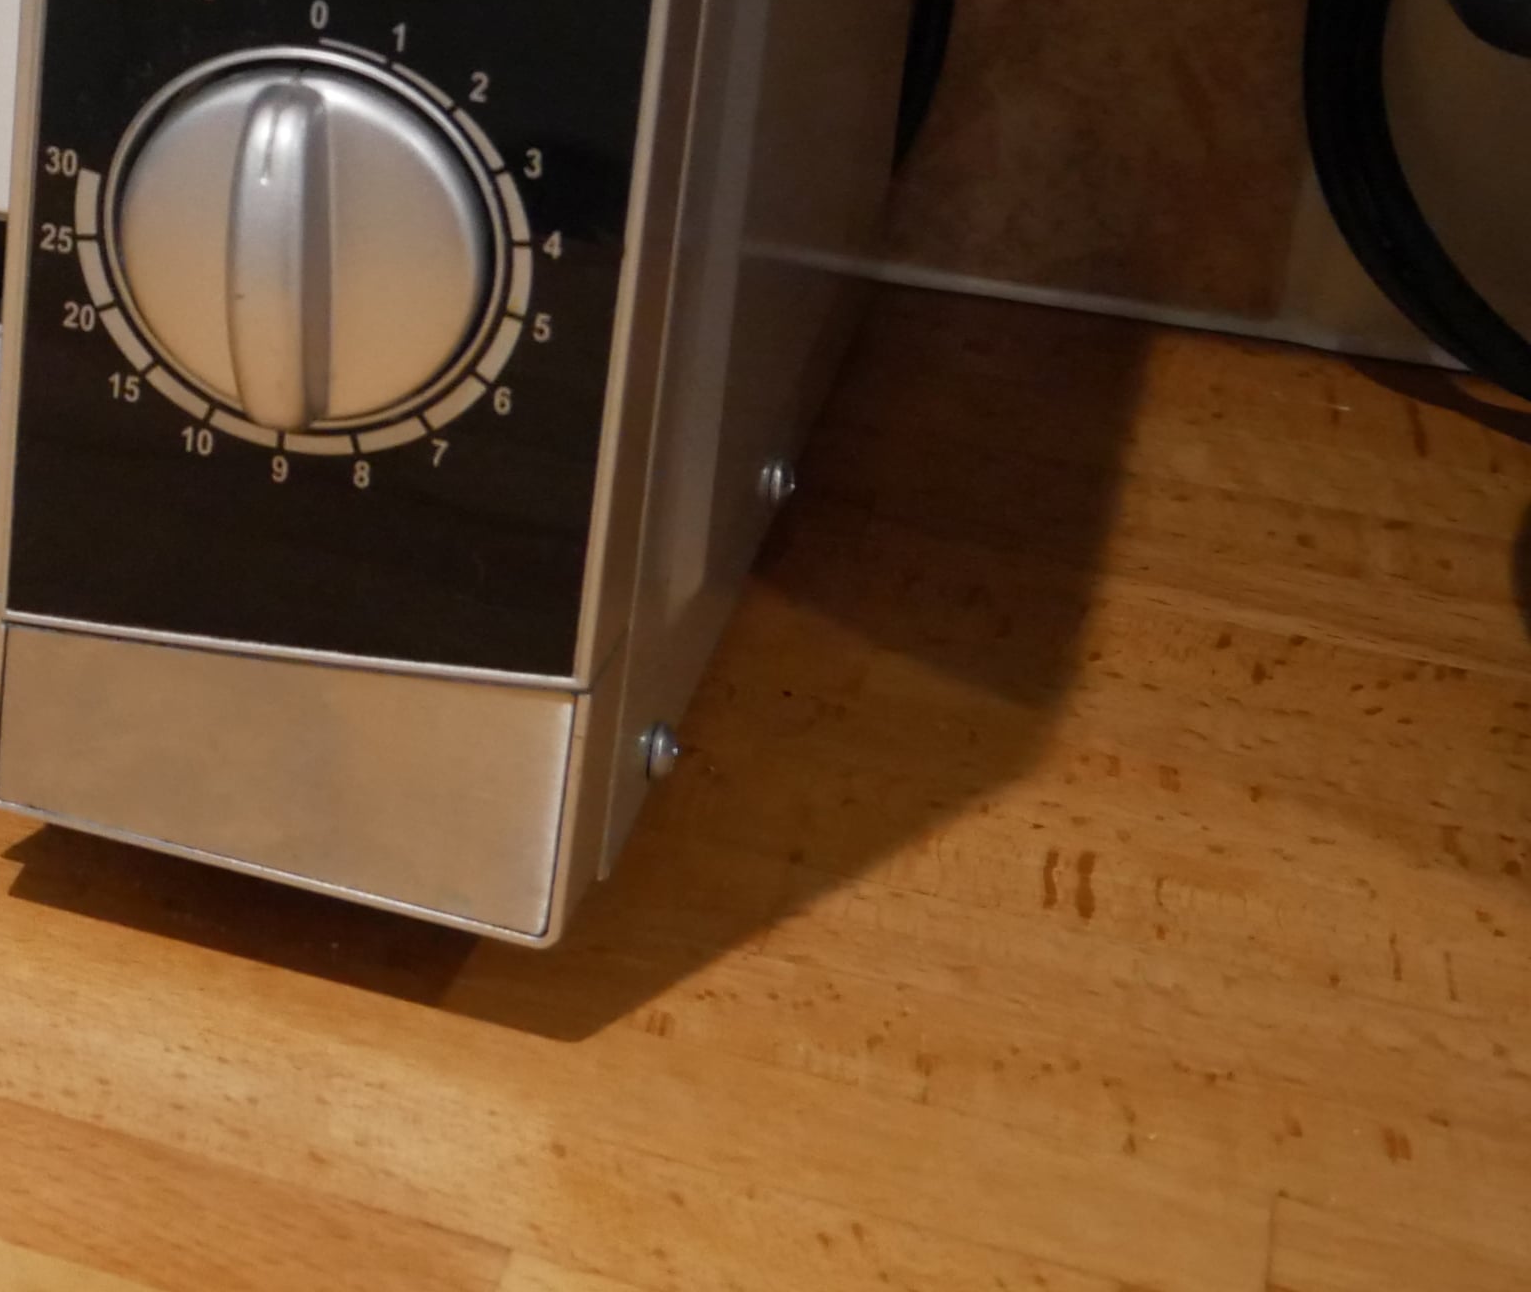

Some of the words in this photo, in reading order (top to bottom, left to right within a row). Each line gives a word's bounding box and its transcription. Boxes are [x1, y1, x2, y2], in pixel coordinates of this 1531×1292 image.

[311, 0, 329, 30] 0
[392, 23, 407, 52] 1
[469, 73, 489, 103] 2
[45, 147, 78, 176] 30
[524, 149, 543, 179] 3
[41, 223, 73, 254] 25
[542, 230, 563, 259] 4
[63, 302, 96, 331] 20
[533, 312, 552, 342] 5
[108, 373, 140, 402] 15
[493, 385, 513, 416] 6
[182, 428, 214, 456] 10
[431, 440, 449, 468] 7
[272, 454, 288, 482] 9
[352, 460, 370, 488] 8
